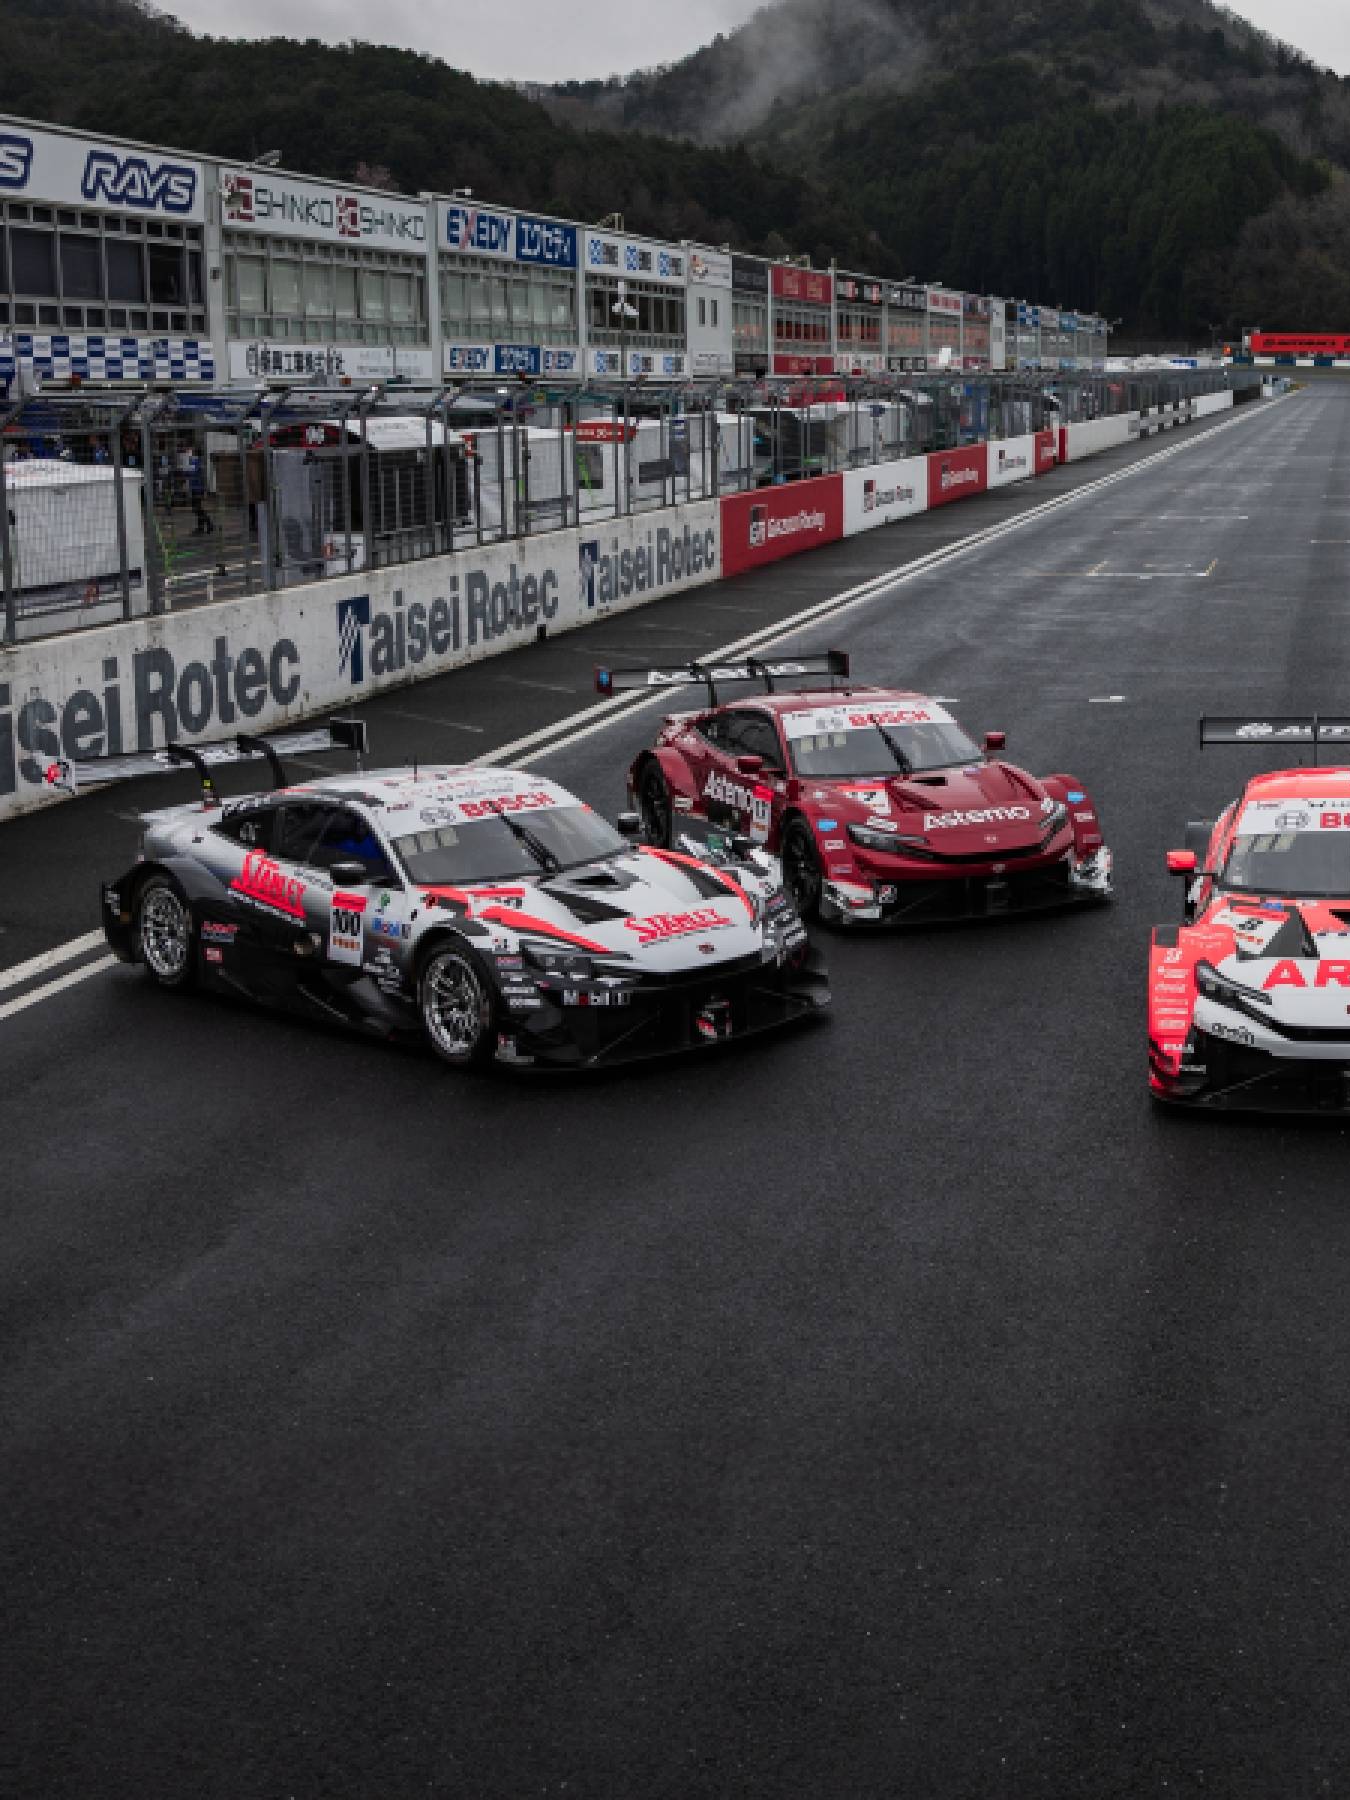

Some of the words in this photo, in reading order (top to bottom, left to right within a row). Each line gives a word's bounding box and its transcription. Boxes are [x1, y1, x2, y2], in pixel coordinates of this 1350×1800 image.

[82, 150, 196, 212] RAYS
[255, 188, 333, 228] SHINKO
[361, 207, 426, 240] SHINKO
[447, 207, 512, 252] EXEDY
[657, 526, 716, 582] Rotec
[465, 564, 560, 646] Rotec
[133, 636, 302, 746] Rotec
[847, 709, 932, 728] BOSCH
[459, 791, 557, 818] BOSCH
[923, 805, 1031, 832] Astemo
[332, 908, 361, 937] 100
[562, 989, 610, 1007] Mobil
